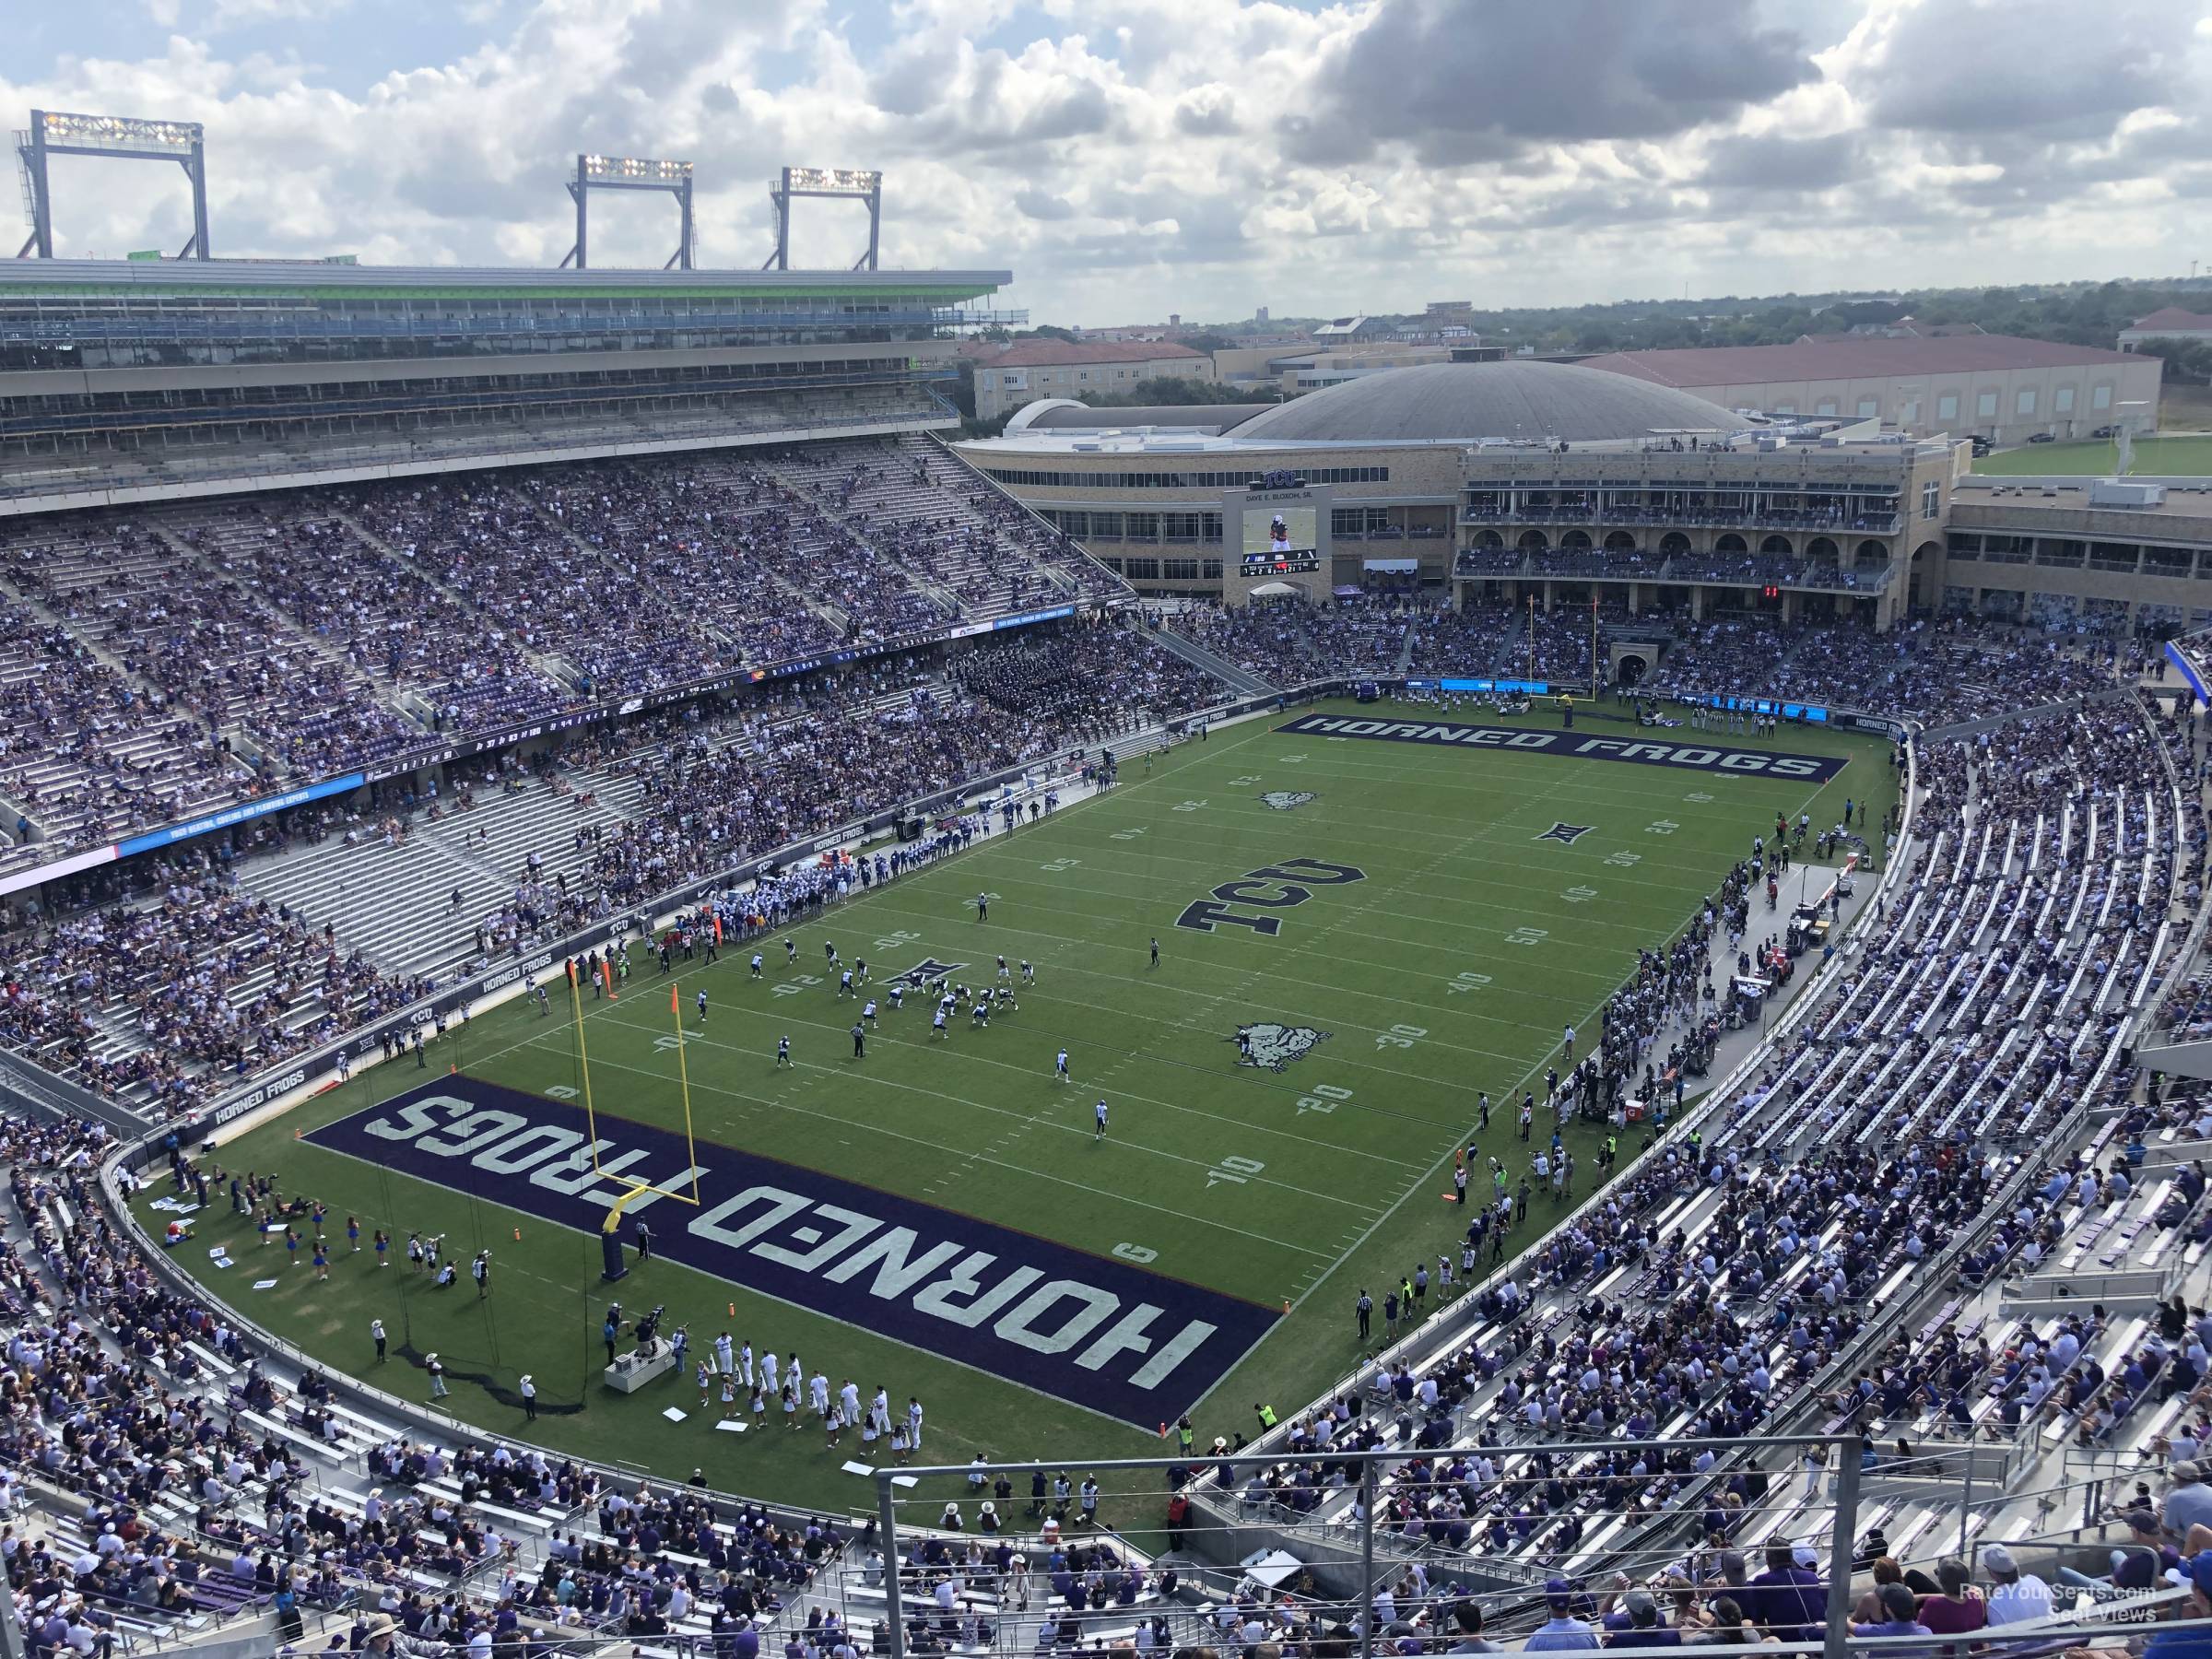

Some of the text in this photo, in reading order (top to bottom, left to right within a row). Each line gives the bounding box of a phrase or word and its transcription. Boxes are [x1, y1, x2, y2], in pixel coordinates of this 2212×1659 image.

[1261, 468, 1296, 488] TCU
[1246, 494, 1262, 502] DAVE
[1856, 718, 1888, 730] HORNED
[1298, 718, 1823, 776] HORNED FROGS
[814, 825, 865, 852] HORNED FROGS
[1645, 821, 1680, 835] 20
[1040, 857, 1082, 872] 50
[1604, 852, 1641, 867] 30
[1173, 857, 1369, 937] TCU
[610, 919, 629, 936] TCU
[1504, 926, 1548, 946] 50
[874, 930, 921, 949] 30
[483, 953, 552, 993] HORNED FROGS
[1450, 971, 1493, 993] 40
[771, 974, 824, 995] 20
[410, 1007, 433, 1024] TCU
[1376, 1024, 1428, 1048] 30
[216, 1069, 305, 1124] HORNED FROGS
[1296, 1084, 1353, 1114] 20
[1206, 1156, 1265, 1184] 10
[364, 1095, 1218, 1391] HORNED FROGS
